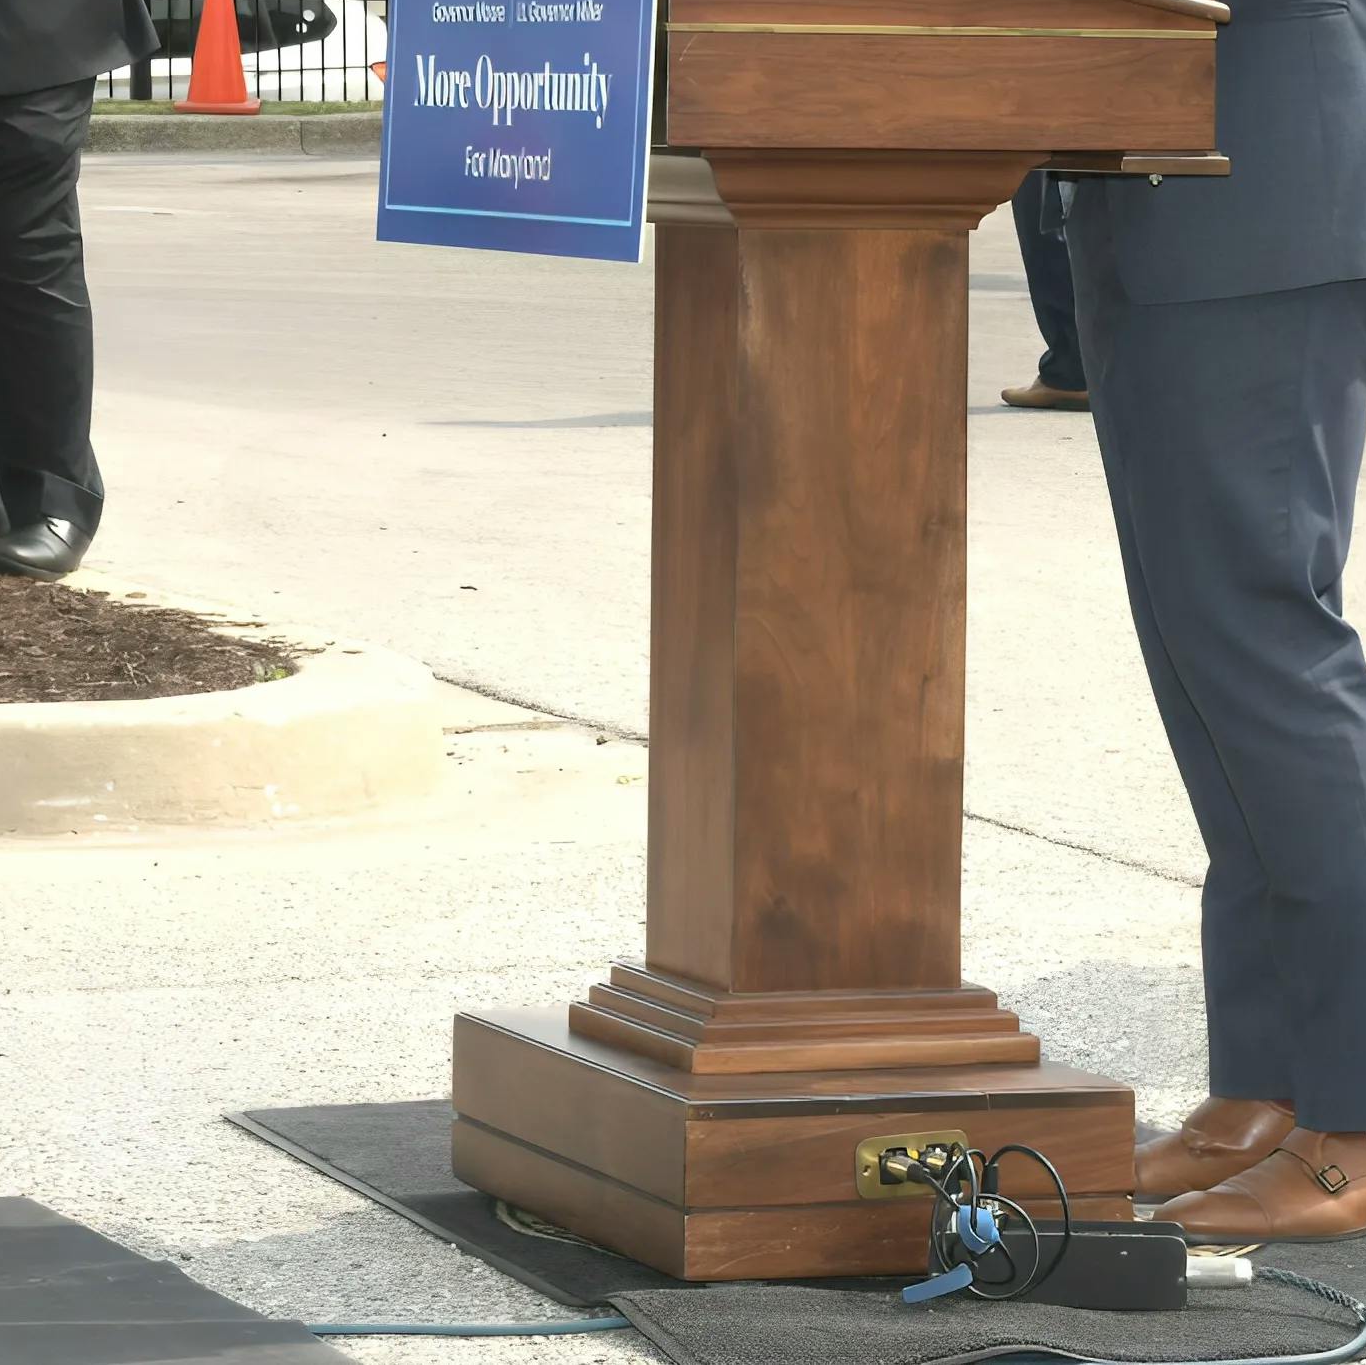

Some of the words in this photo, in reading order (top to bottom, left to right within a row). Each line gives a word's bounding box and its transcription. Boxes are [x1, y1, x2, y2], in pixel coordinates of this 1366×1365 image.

[414, 54, 471, 109] More
[475, 51, 613, 130] Opportunity
[464, 145, 487, 178] For
[488, 146, 552, 190] Maryland
